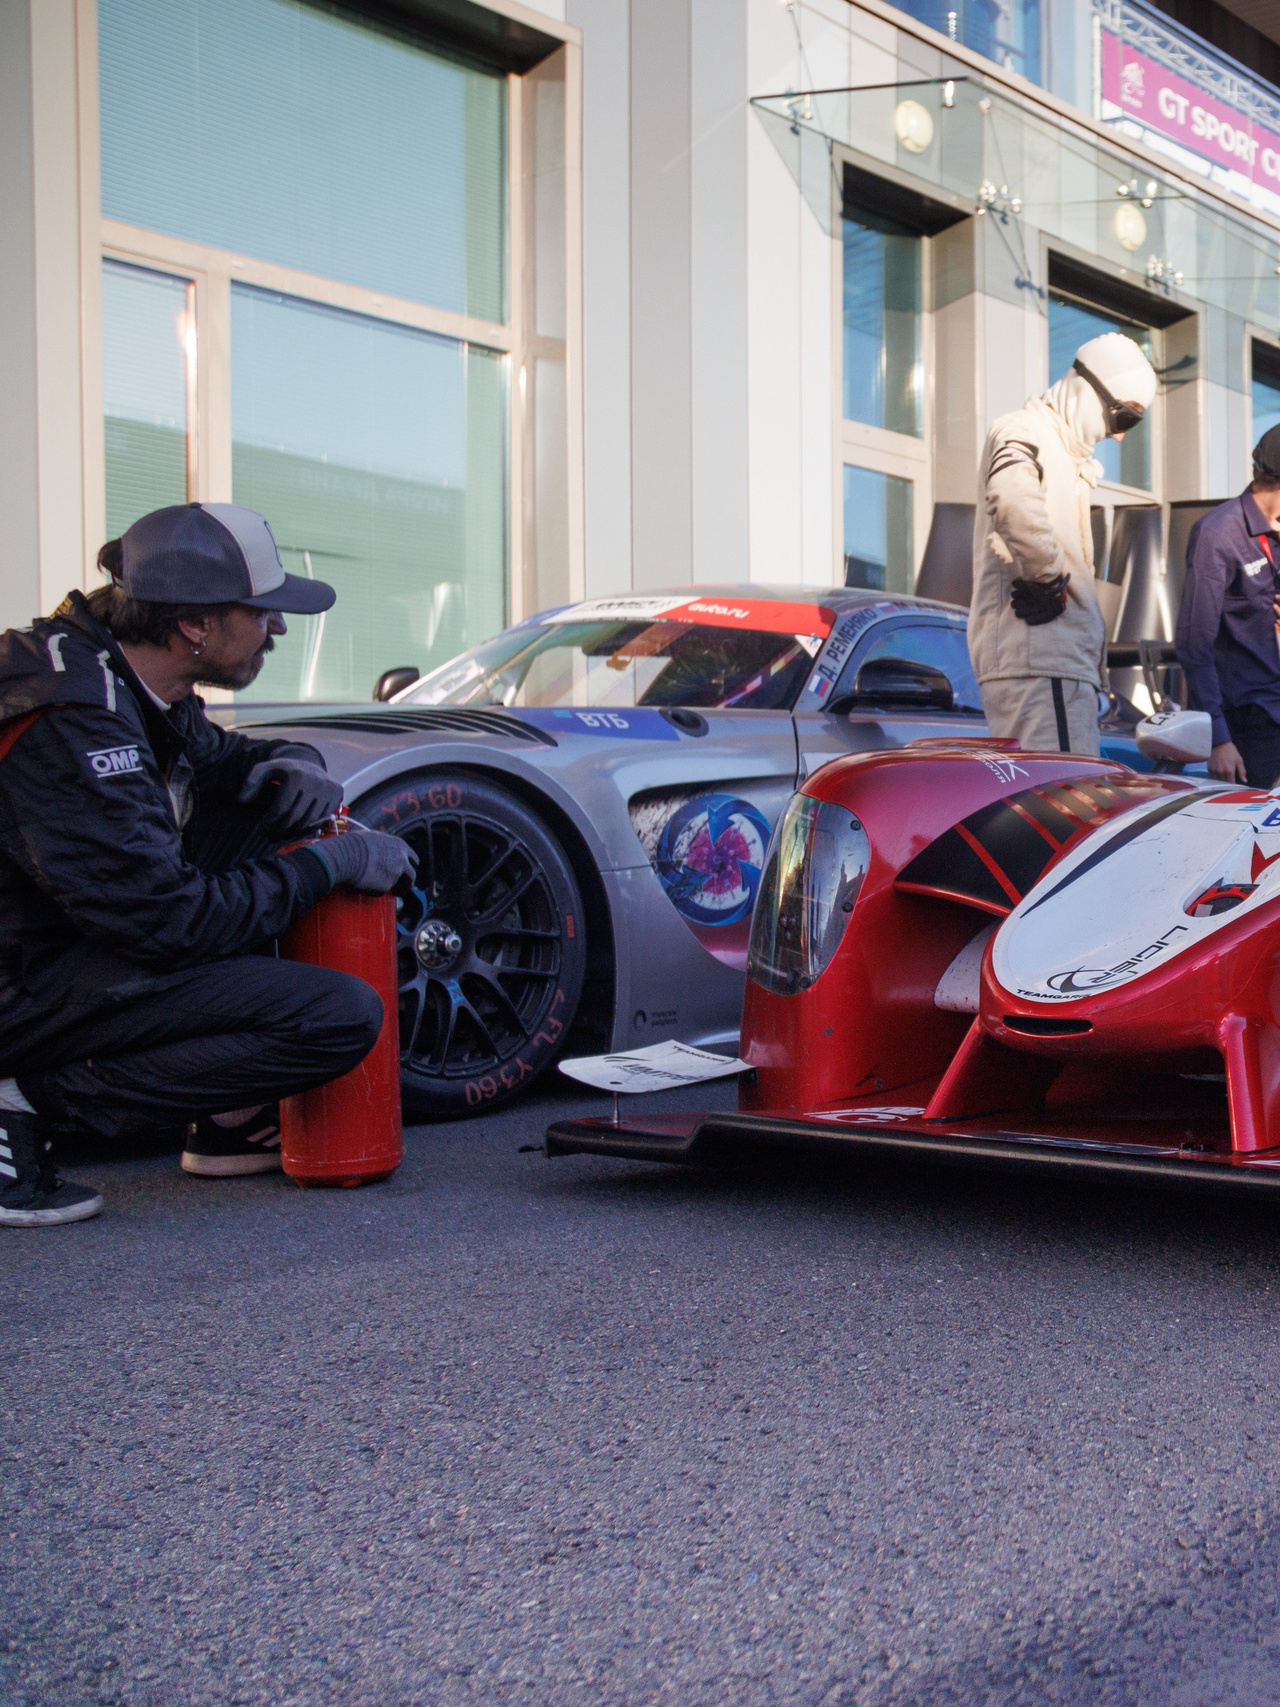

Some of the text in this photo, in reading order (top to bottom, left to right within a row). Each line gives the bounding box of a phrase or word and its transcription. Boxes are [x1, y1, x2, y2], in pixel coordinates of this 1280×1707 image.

[1157, 87, 1190, 125] GT
[1190, 105, 1260, 168] SPORT
[687, 600, 749, 619] auto.ru
[576, 712, 630, 730] ВТБ
[92, 748, 140, 774] OMP
[1088, 925, 1189, 983] LIGIER
